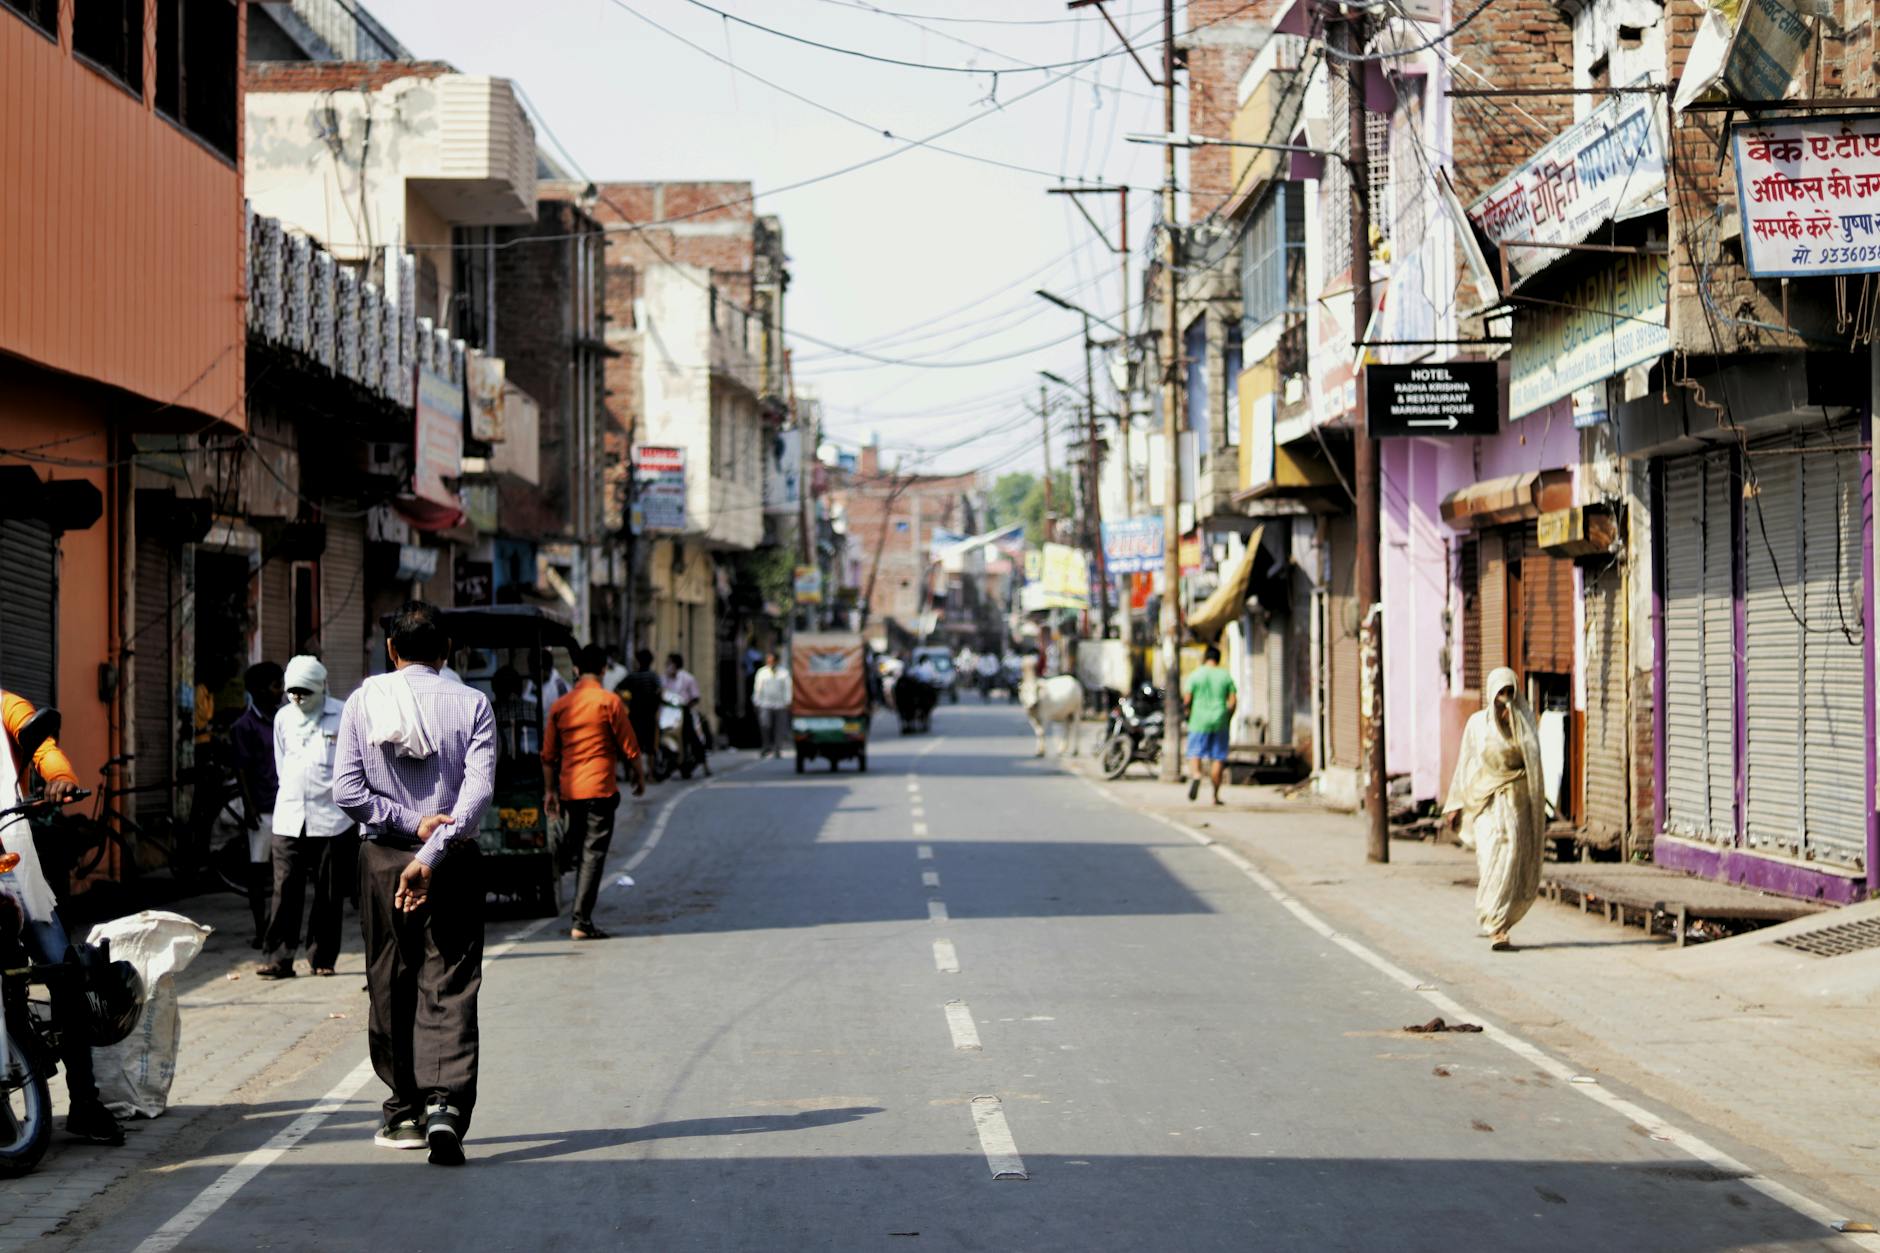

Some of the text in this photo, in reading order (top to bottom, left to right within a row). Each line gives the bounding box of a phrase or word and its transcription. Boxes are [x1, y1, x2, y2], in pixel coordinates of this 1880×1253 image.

[1827, 168, 1852, 199] की
[1753, 211, 1803, 243] सम्पर्क
[1411, 369, 1453, 381] HOTEL
[1394, 382, 1470, 393] RADHA KRISHNA
[1406, 393, 1467, 403] RESTAURANT
[1391, 404, 1474, 415] MARRIAGE HOUSE
